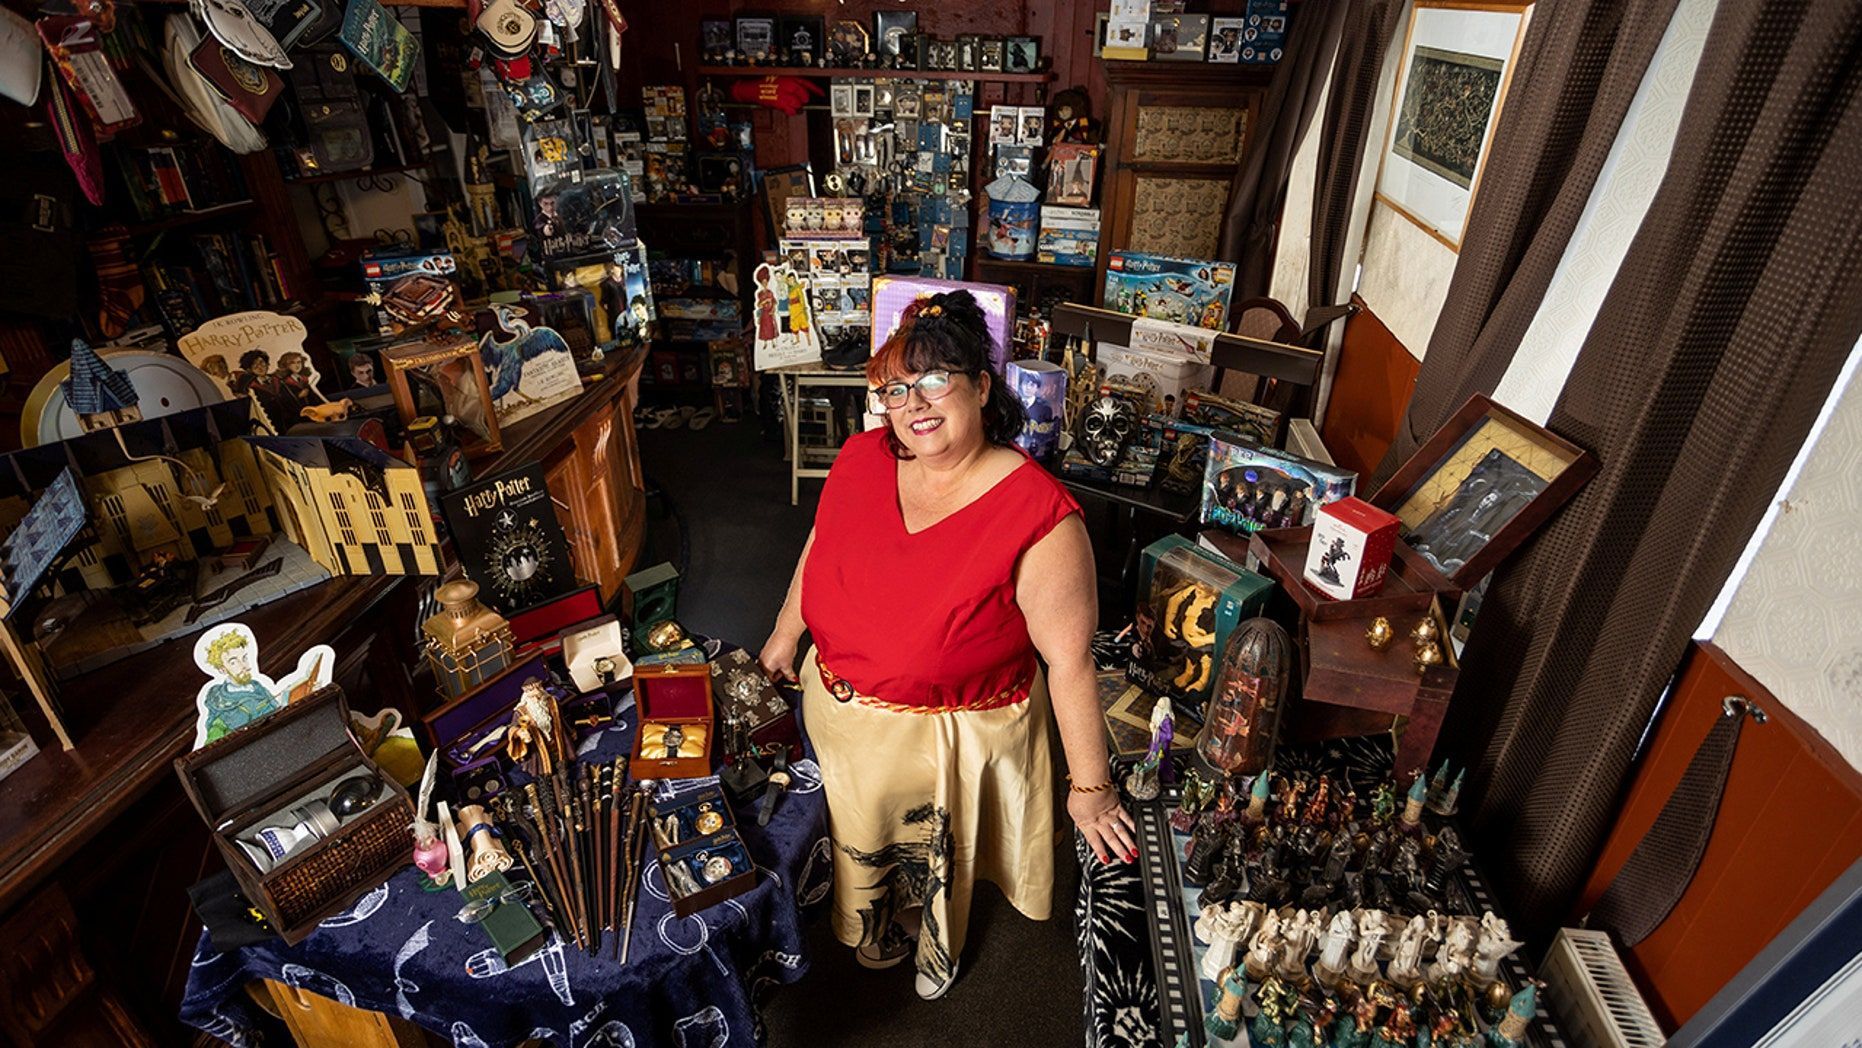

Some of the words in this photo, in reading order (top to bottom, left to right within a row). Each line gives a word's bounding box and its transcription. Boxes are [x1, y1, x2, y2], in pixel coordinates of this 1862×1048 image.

[184, 332, 243, 357] HARRY
[238, 320, 304, 343] POTTER
[463, 489, 497, 517] Harry
[494, 476, 531, 507] Potter
